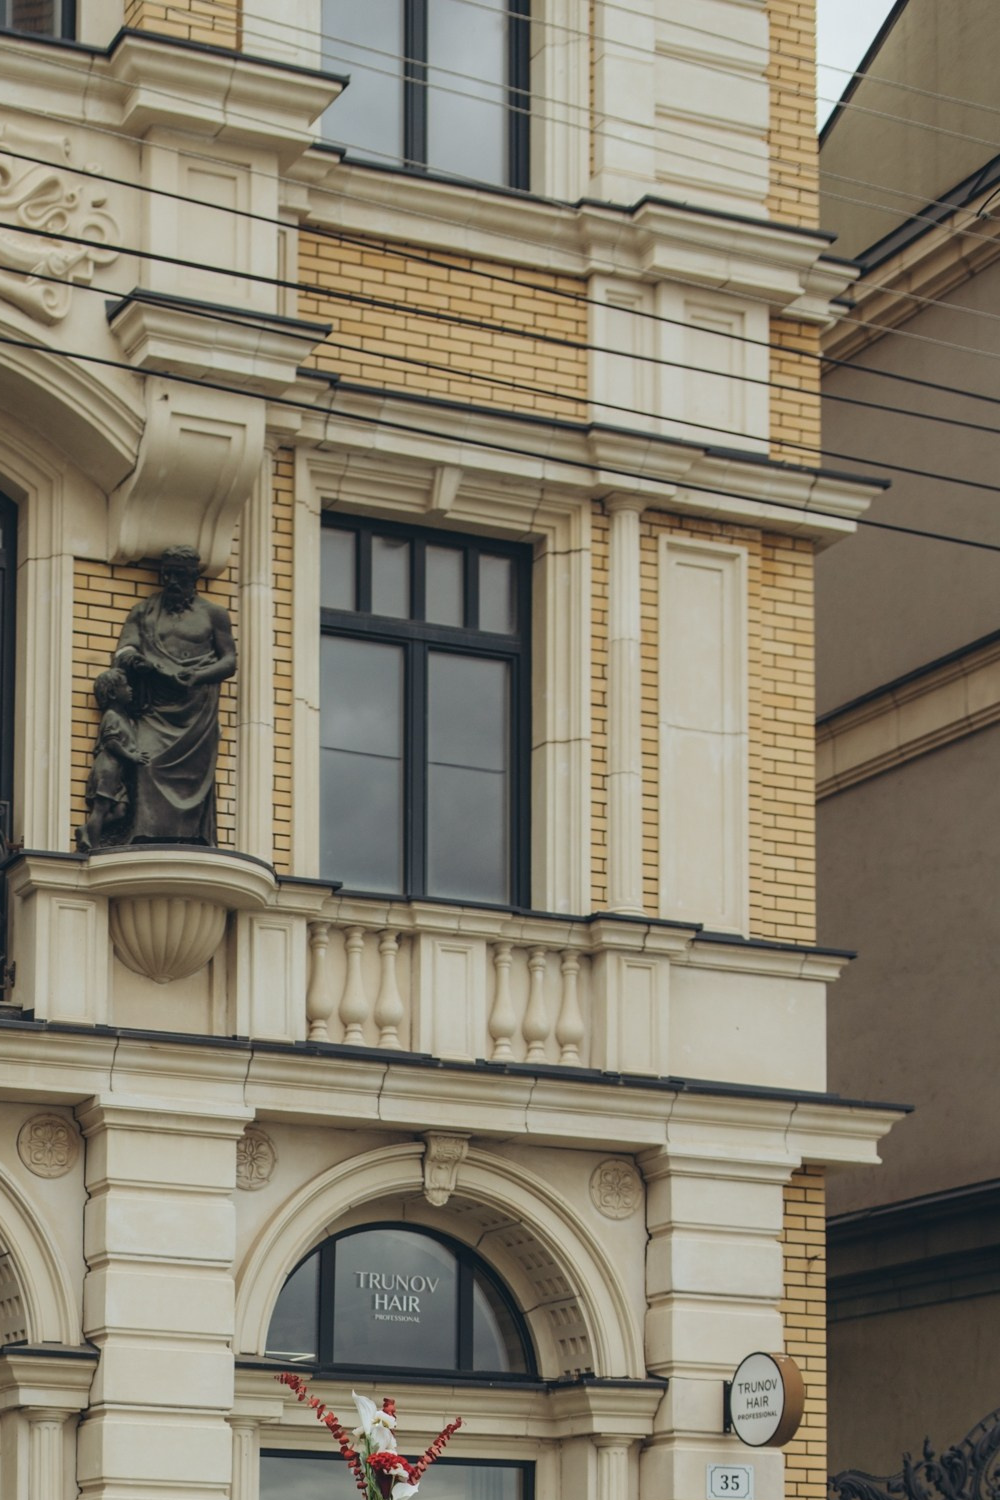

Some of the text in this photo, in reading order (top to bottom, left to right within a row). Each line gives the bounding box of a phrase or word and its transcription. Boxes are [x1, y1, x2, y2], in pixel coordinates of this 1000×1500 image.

[355, 1271, 440, 1293] TRUNOV
[374, 1293, 421, 1313] HAIR
[374, 1313, 421, 1323] PROFESSIONAL
[737, 1378, 778, 1395] TRUNOV
[746, 1395, 769, 1409] HAIR
[737, 1410, 778, 1421] PROFESSIONAL
[720, 1474, 740, 1491] 35
